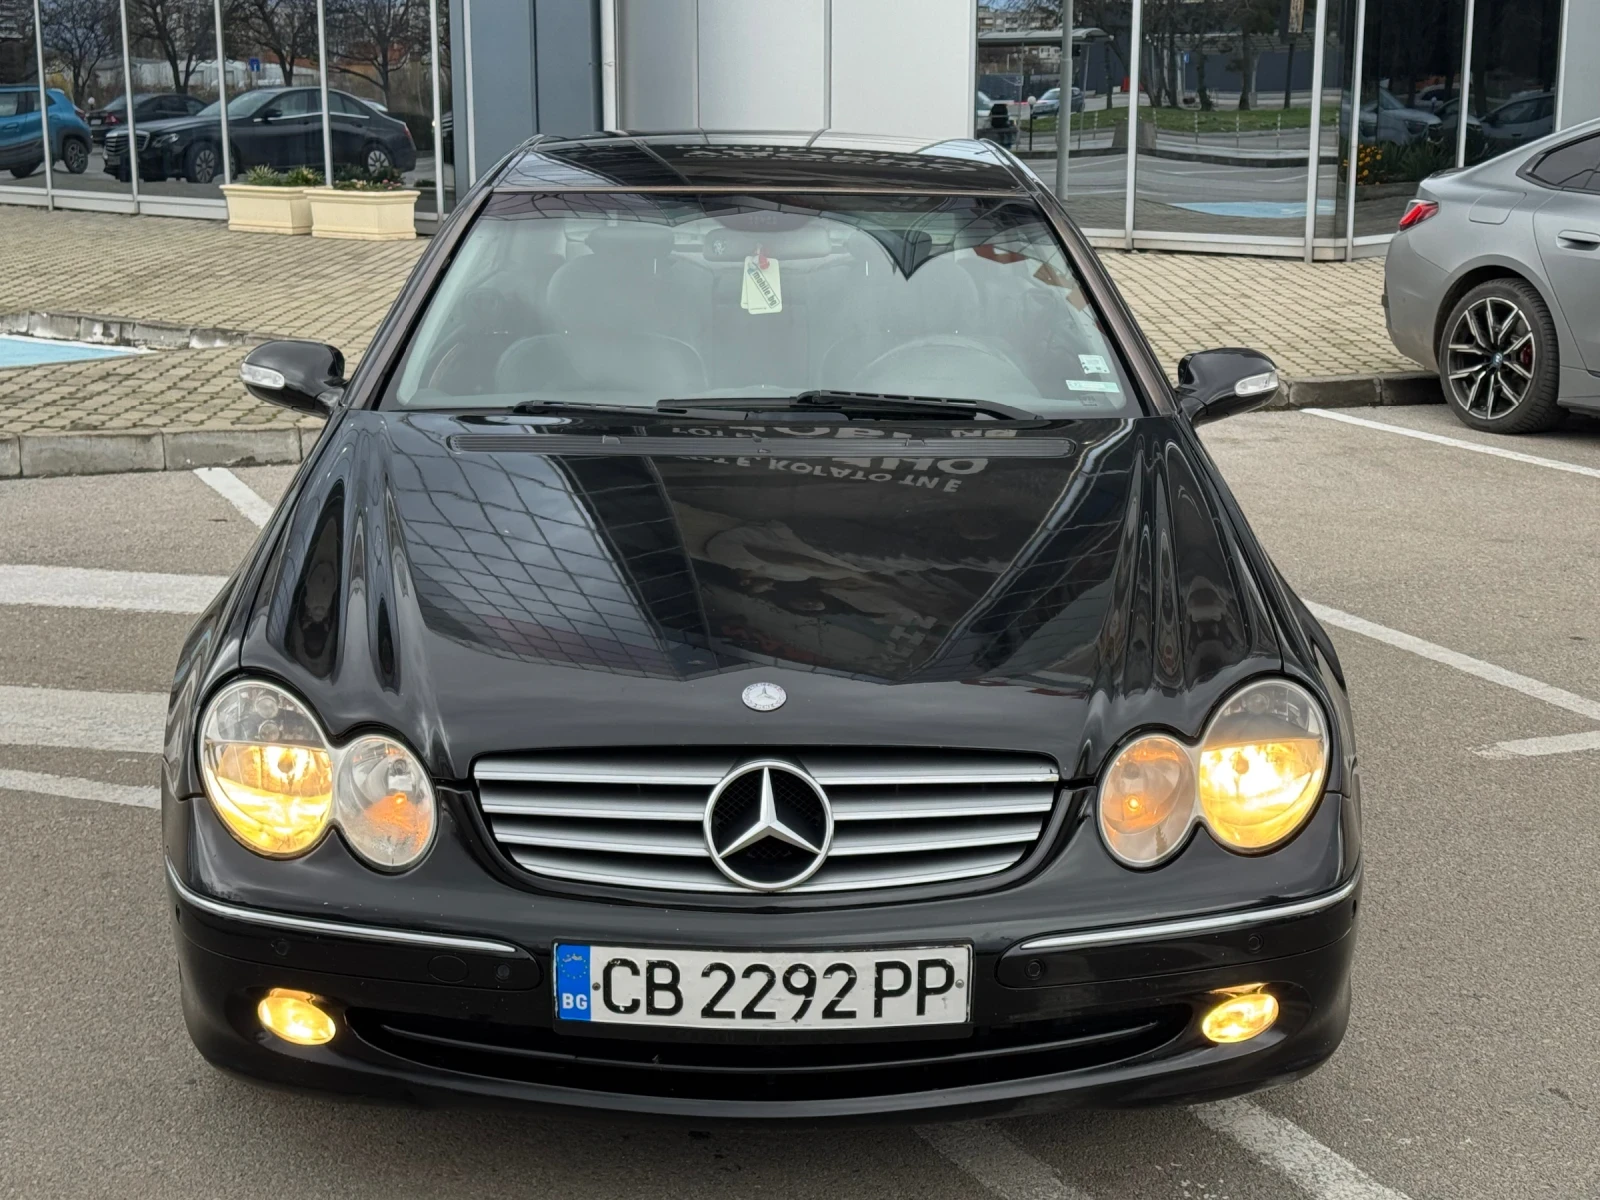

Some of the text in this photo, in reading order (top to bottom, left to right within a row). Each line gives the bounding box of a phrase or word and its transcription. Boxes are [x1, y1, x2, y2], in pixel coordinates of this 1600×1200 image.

[752, 271, 777, 307] mobile.bg
[562, 992, 588, 1010] BG
[602, 957, 956, 1022] CB 2292 PP
